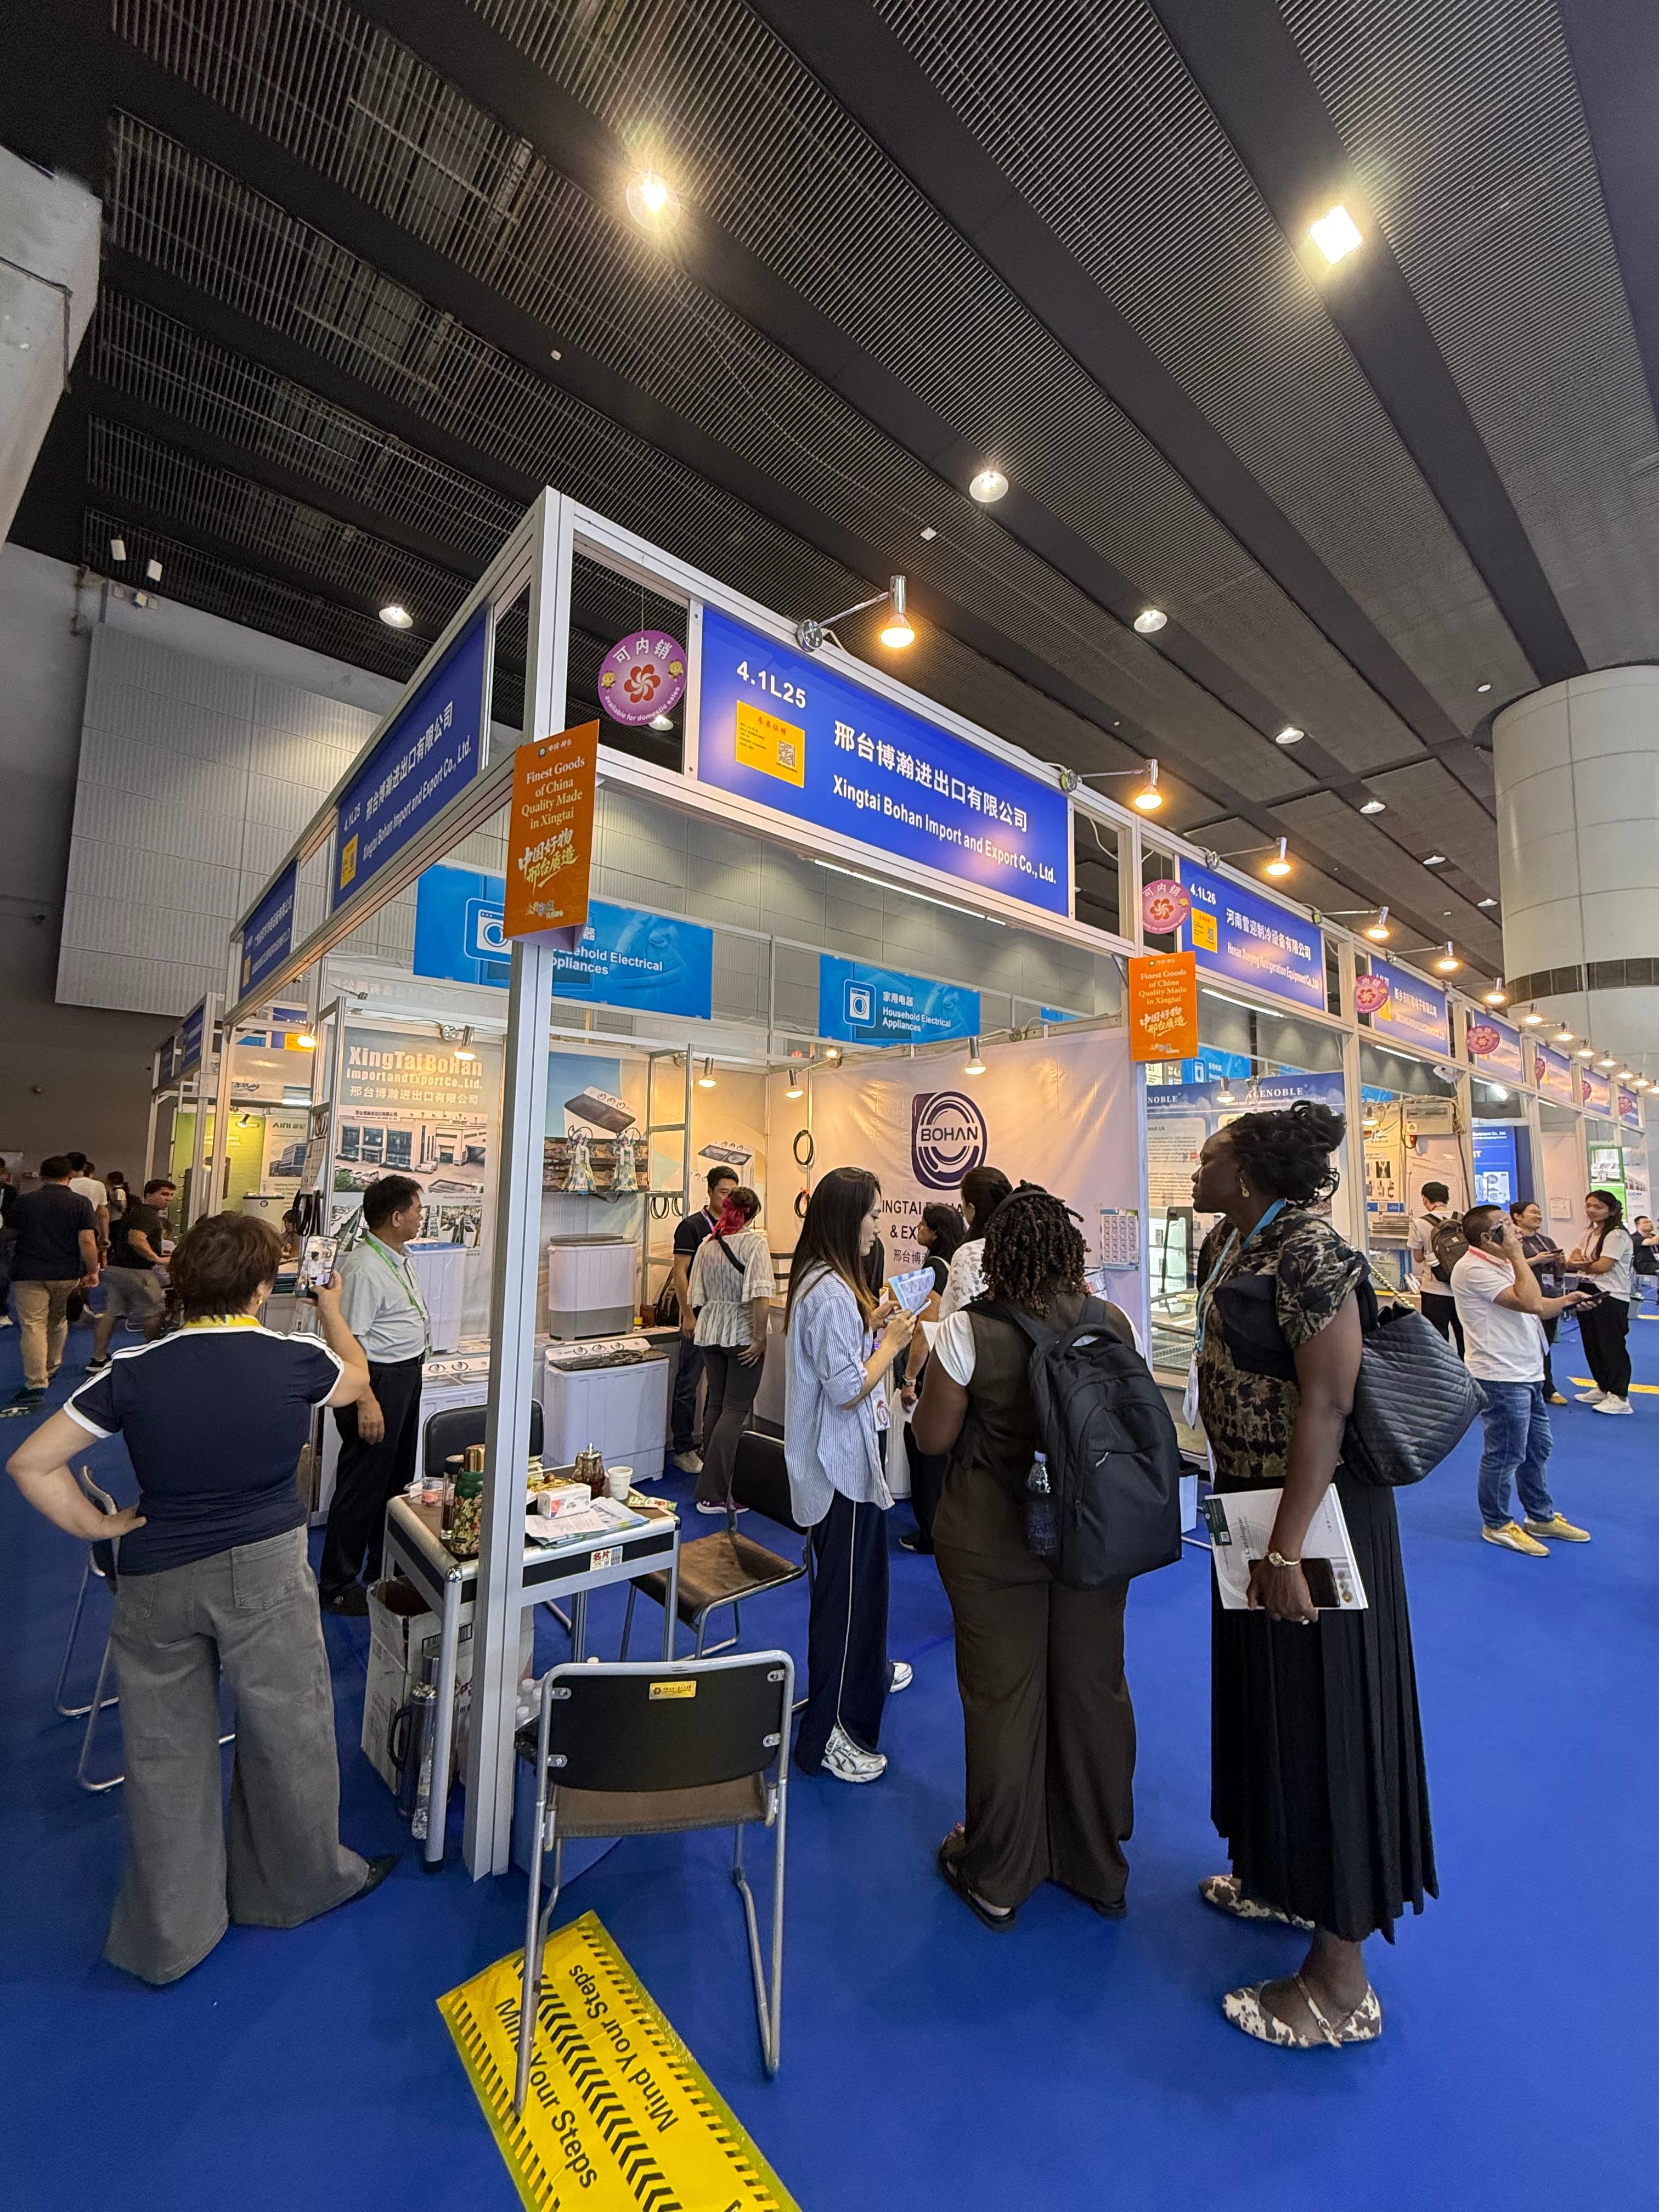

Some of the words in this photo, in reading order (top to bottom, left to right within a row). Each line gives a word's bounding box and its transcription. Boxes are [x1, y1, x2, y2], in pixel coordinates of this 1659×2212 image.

[612, 637, 673, 663] 可内销
[737, 661, 806, 709] 4.1L25
[605, 695, 626, 719] available
[637, 704, 668, 721] domestic
[667, 687, 680, 705] sales
[393, 799, 411, 828] Import
[411, 792, 422, 812] and
[422, 765, 443, 801] Export
[443, 757, 456, 778] Co.,
[458, 734, 471, 764] Ltd.
[526, 766, 552, 784] Finest
[554, 756, 585, 775] Goods
[834, 720, 1028, 833] 邢台博瀚进出口有限公司
[535, 784, 545, 798] of
[546, 778, 574, 794] China
[521, 798, 555, 816] Quality
[556, 789, 583, 806] Made
[530, 819, 539, 830] in
[540, 807, 574, 826] Xingtai
[833, 774, 881, 811] Xingtai
[883, 796, 922, 829] Bohan
[926, 814, 962, 845] Import
[964, 834, 983, 854] and
[985, 840, 1018, 868] Export
[1019, 854, 1037, 879] Co.,
[1039, 862, 1057, 884] Ltd.
[518, 827, 574, 883] 中国好物
[526, 844, 580, 897] 邢台质造
[1190, 883, 1216, 905] 4.1L26
[610, 951, 663, 972] Electrical
[1158, 979, 1180, 988] China
[1163, 969, 1187, 978] Goods
[883, 991, 913, 1007] 家用电器
[1138, 989, 1165, 997] Quality
[1155, 995, 1181, 1005] Xingtai
[882, 1017, 922, 1031] Appliances
[883, 1006, 920, 1022] Household
[921, 1014, 951, 1028] Electrical
[350, 1085, 479, 1105] 邢台博瀚进出口有限公司
[921, 1126, 978, 1142] BOHAN
[882, 1199, 922, 1215] INGTAI
[890, 1224, 898, 1239] &
[593, 1550, 611, 1561] 名片
[568, 1963, 609, 2019] Steps
[601, 2017, 639, 2075] Your
[628, 2068, 680, 2134] Mind
[551, 2108, 599, 2190] Steps
